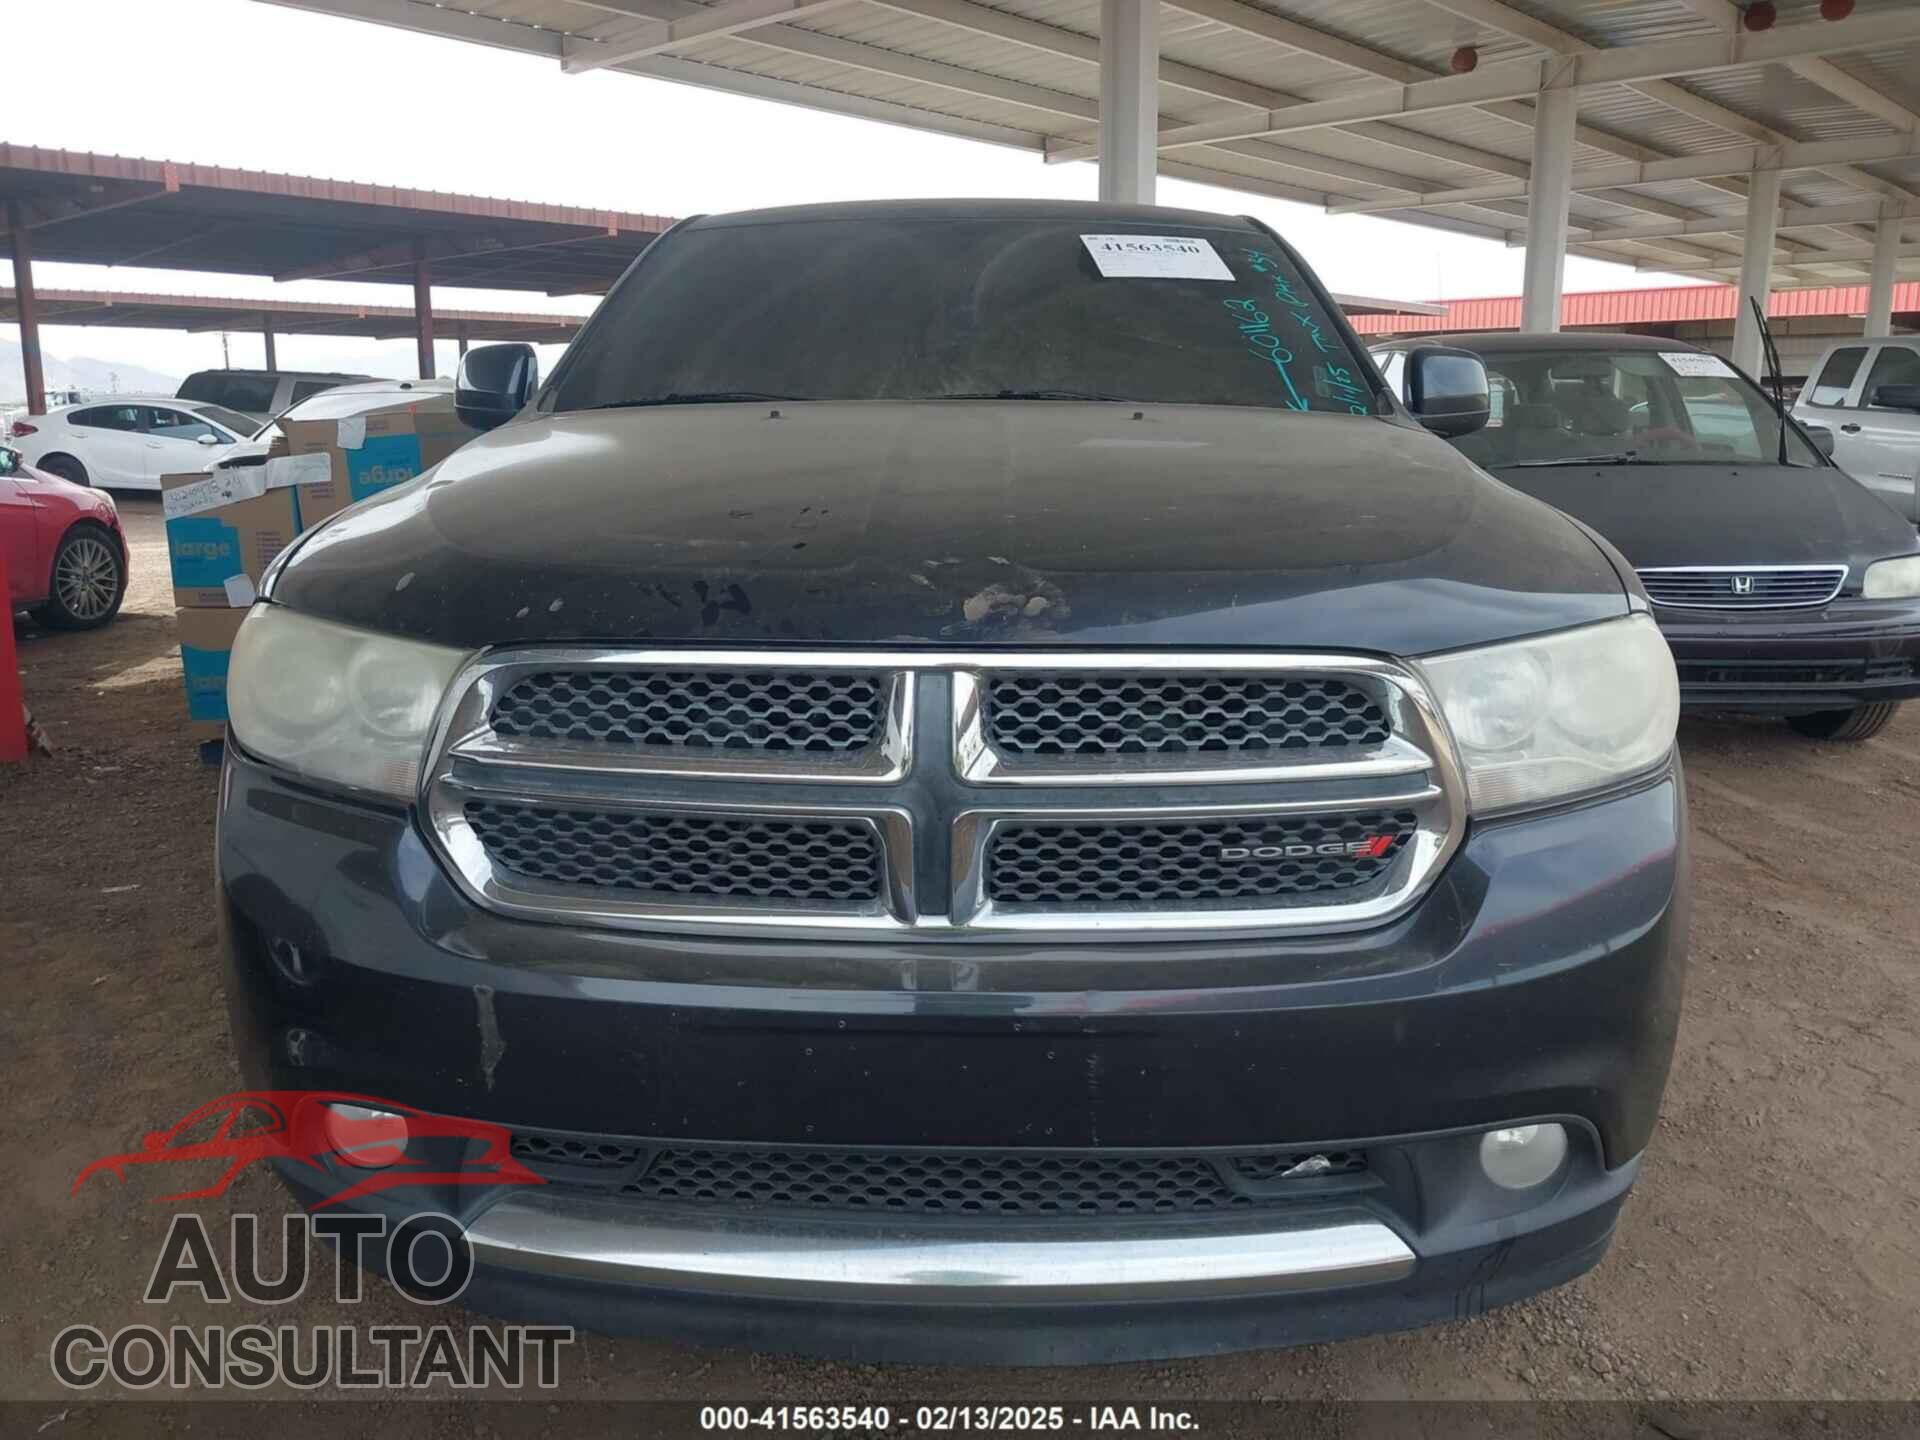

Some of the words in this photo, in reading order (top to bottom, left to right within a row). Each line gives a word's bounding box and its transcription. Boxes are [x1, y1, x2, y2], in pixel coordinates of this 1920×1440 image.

[1101, 242, 1201, 254] 41563540
[174, 540, 234, 561] large
[1220, 840, 1373, 860] DODGE
